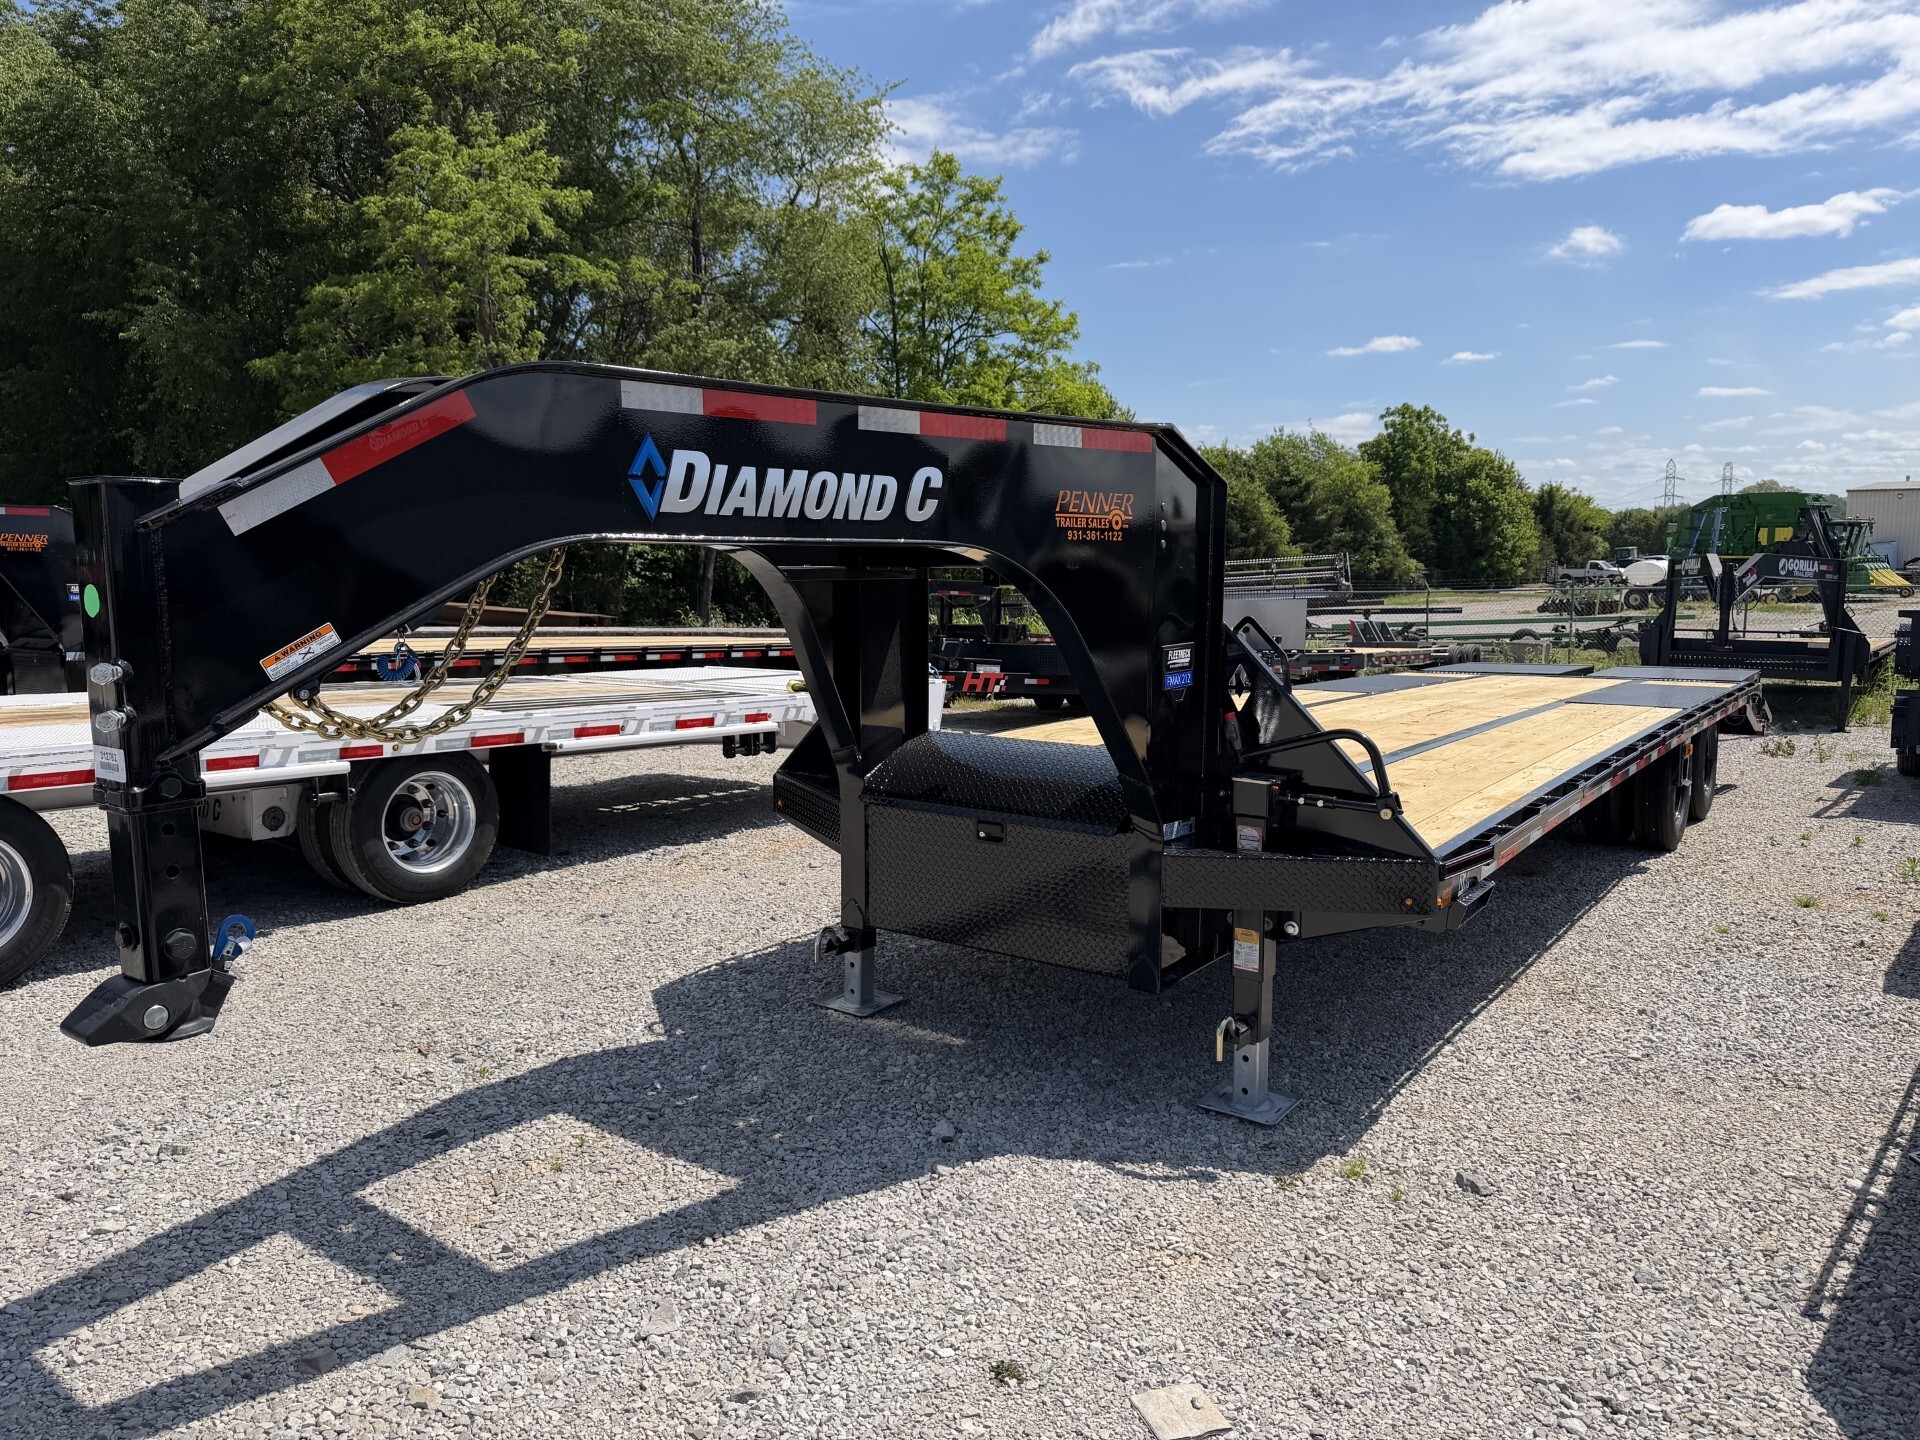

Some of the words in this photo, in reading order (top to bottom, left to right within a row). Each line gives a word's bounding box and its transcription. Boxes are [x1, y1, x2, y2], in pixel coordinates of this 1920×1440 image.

[659, 449, 899, 521] DIAMOND
[905, 466, 943, 522] C
[1056, 489, 1135, 515] PENNER
[1055, 517, 1087, 529] TRAILER
[1088, 518, 1110, 529] SALES
[0, 533, 48, 543] PENNER
[1067, 530, 1123, 541] 931-361-1122
[1788, 558, 1819, 573] GORILLA
[1793, 570, 1814, 578] TRAILERS
[280, 631, 322, 657] WARNING
[1168, 648, 1191, 660] FLEETNECK
[1166, 674, 1182, 687] FMAX
[1182, 673, 1191, 684] 212
[212, 798, 222, 821] C
